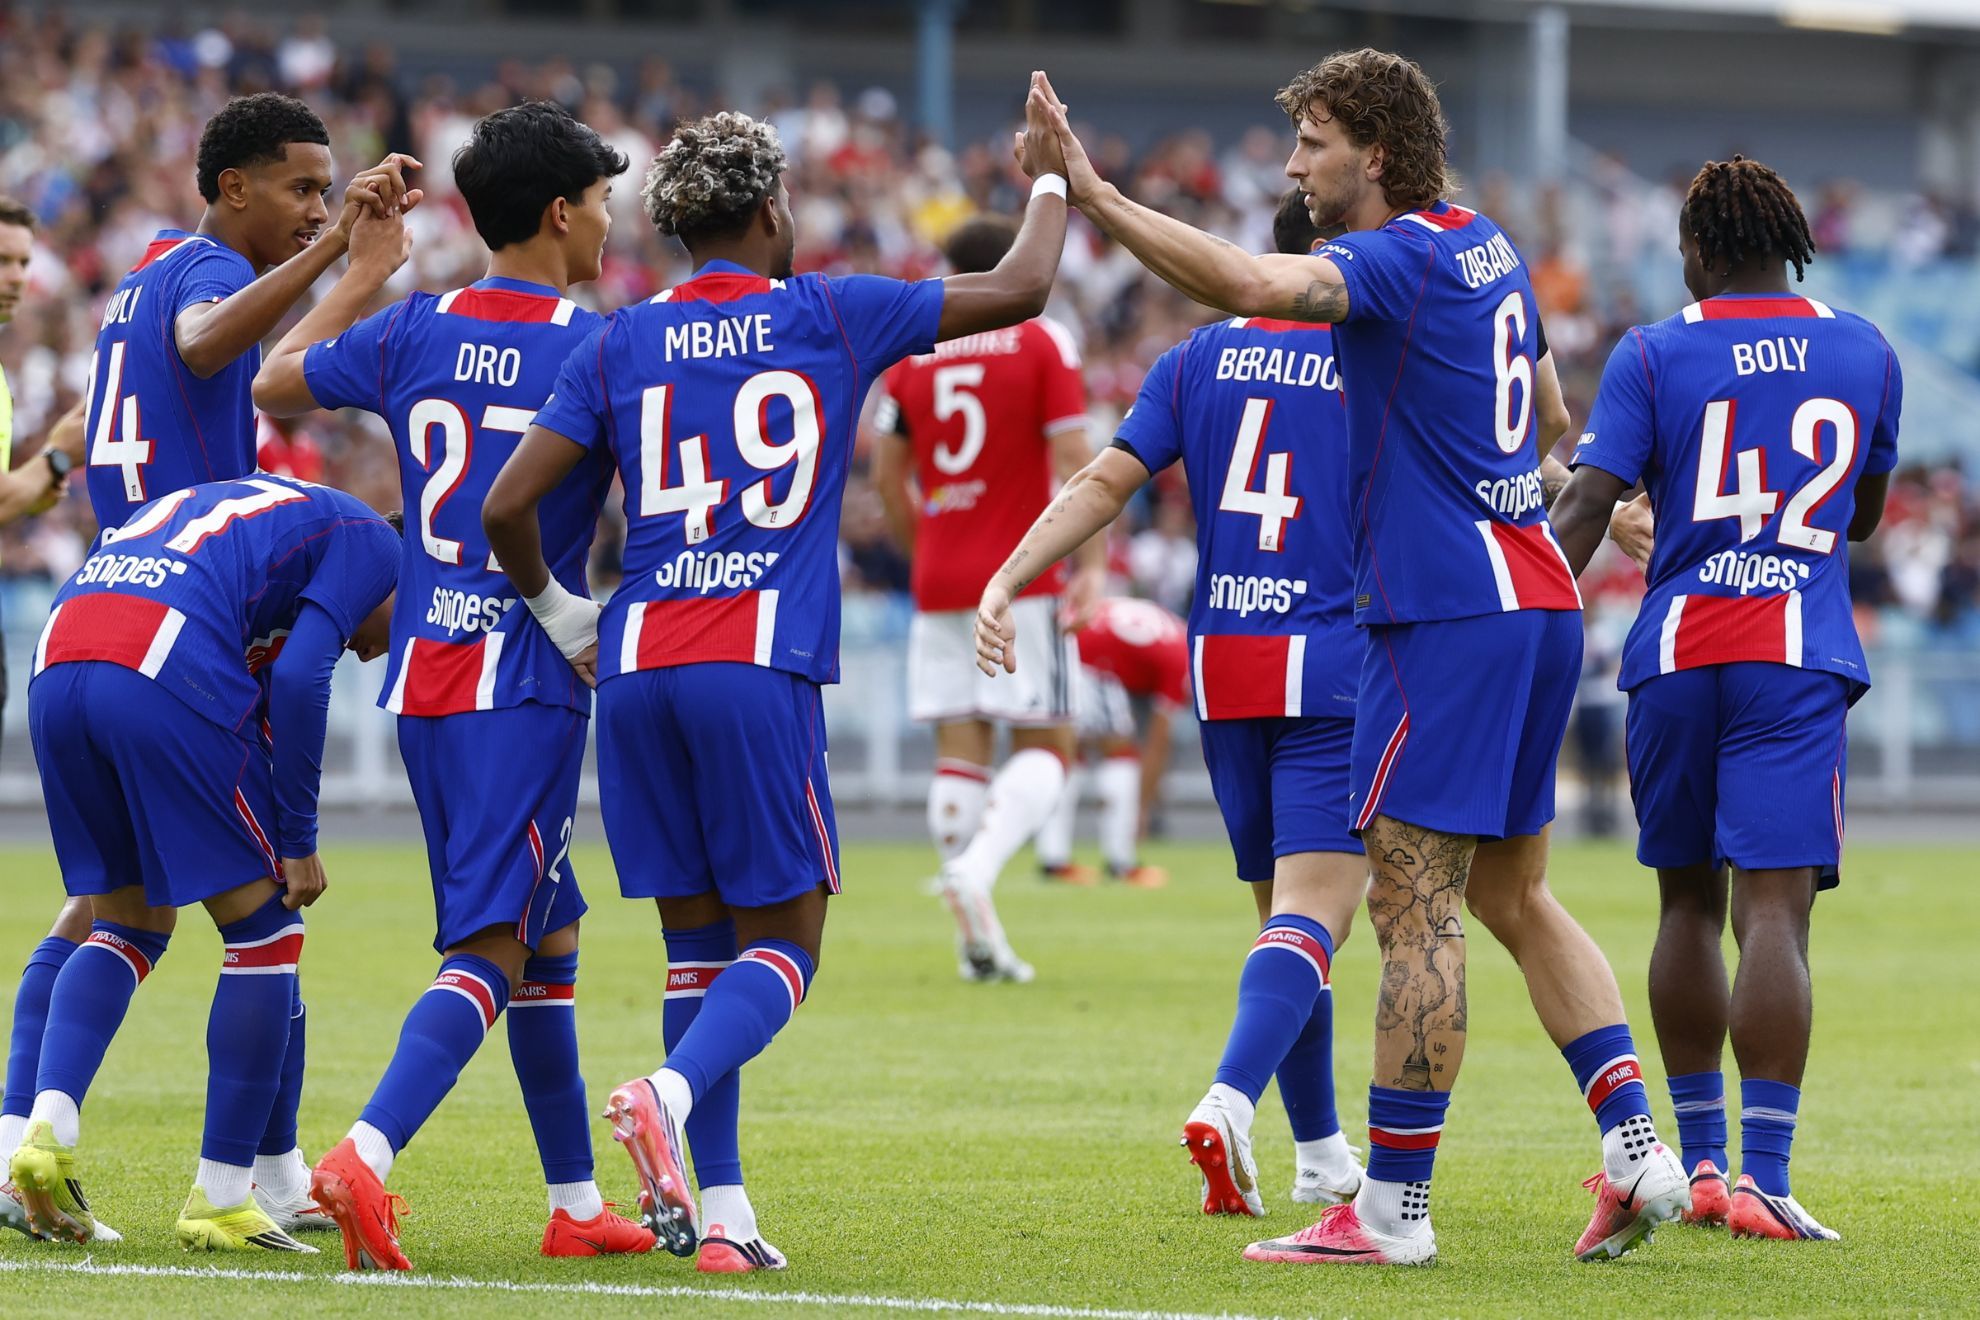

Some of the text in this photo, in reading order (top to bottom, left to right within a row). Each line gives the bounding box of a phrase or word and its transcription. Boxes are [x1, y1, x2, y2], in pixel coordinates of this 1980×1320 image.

[665, 313, 774, 363] MBAYE
[1732, 336, 1809, 376] BOLY
[454, 342, 521, 387] DRO
[1215, 346, 1339, 391] BERALDO
[1493, 291, 1534, 455] 6
[84, 340, 157, 503] 4
[933, 362, 986, 475] 5
[640, 370, 827, 546] 49
[1218, 397, 1304, 552] 4
[1692, 397, 1860, 556] 42
[1475, 466, 1542, 520] snipes
[76, 553, 172, 588] snipes
[656, 550, 766, 595] snipes
[1698, 549, 1799, 595] snipes
[426, 586, 502, 636] snipes
[1209, 573, 1293, 618] snipes
[93, 932, 128, 949] PARIS
[1267, 932, 1304, 945] PARIS
[670, 971, 698, 986] PARIS
[1606, 1064, 1634, 1087] PARIS
